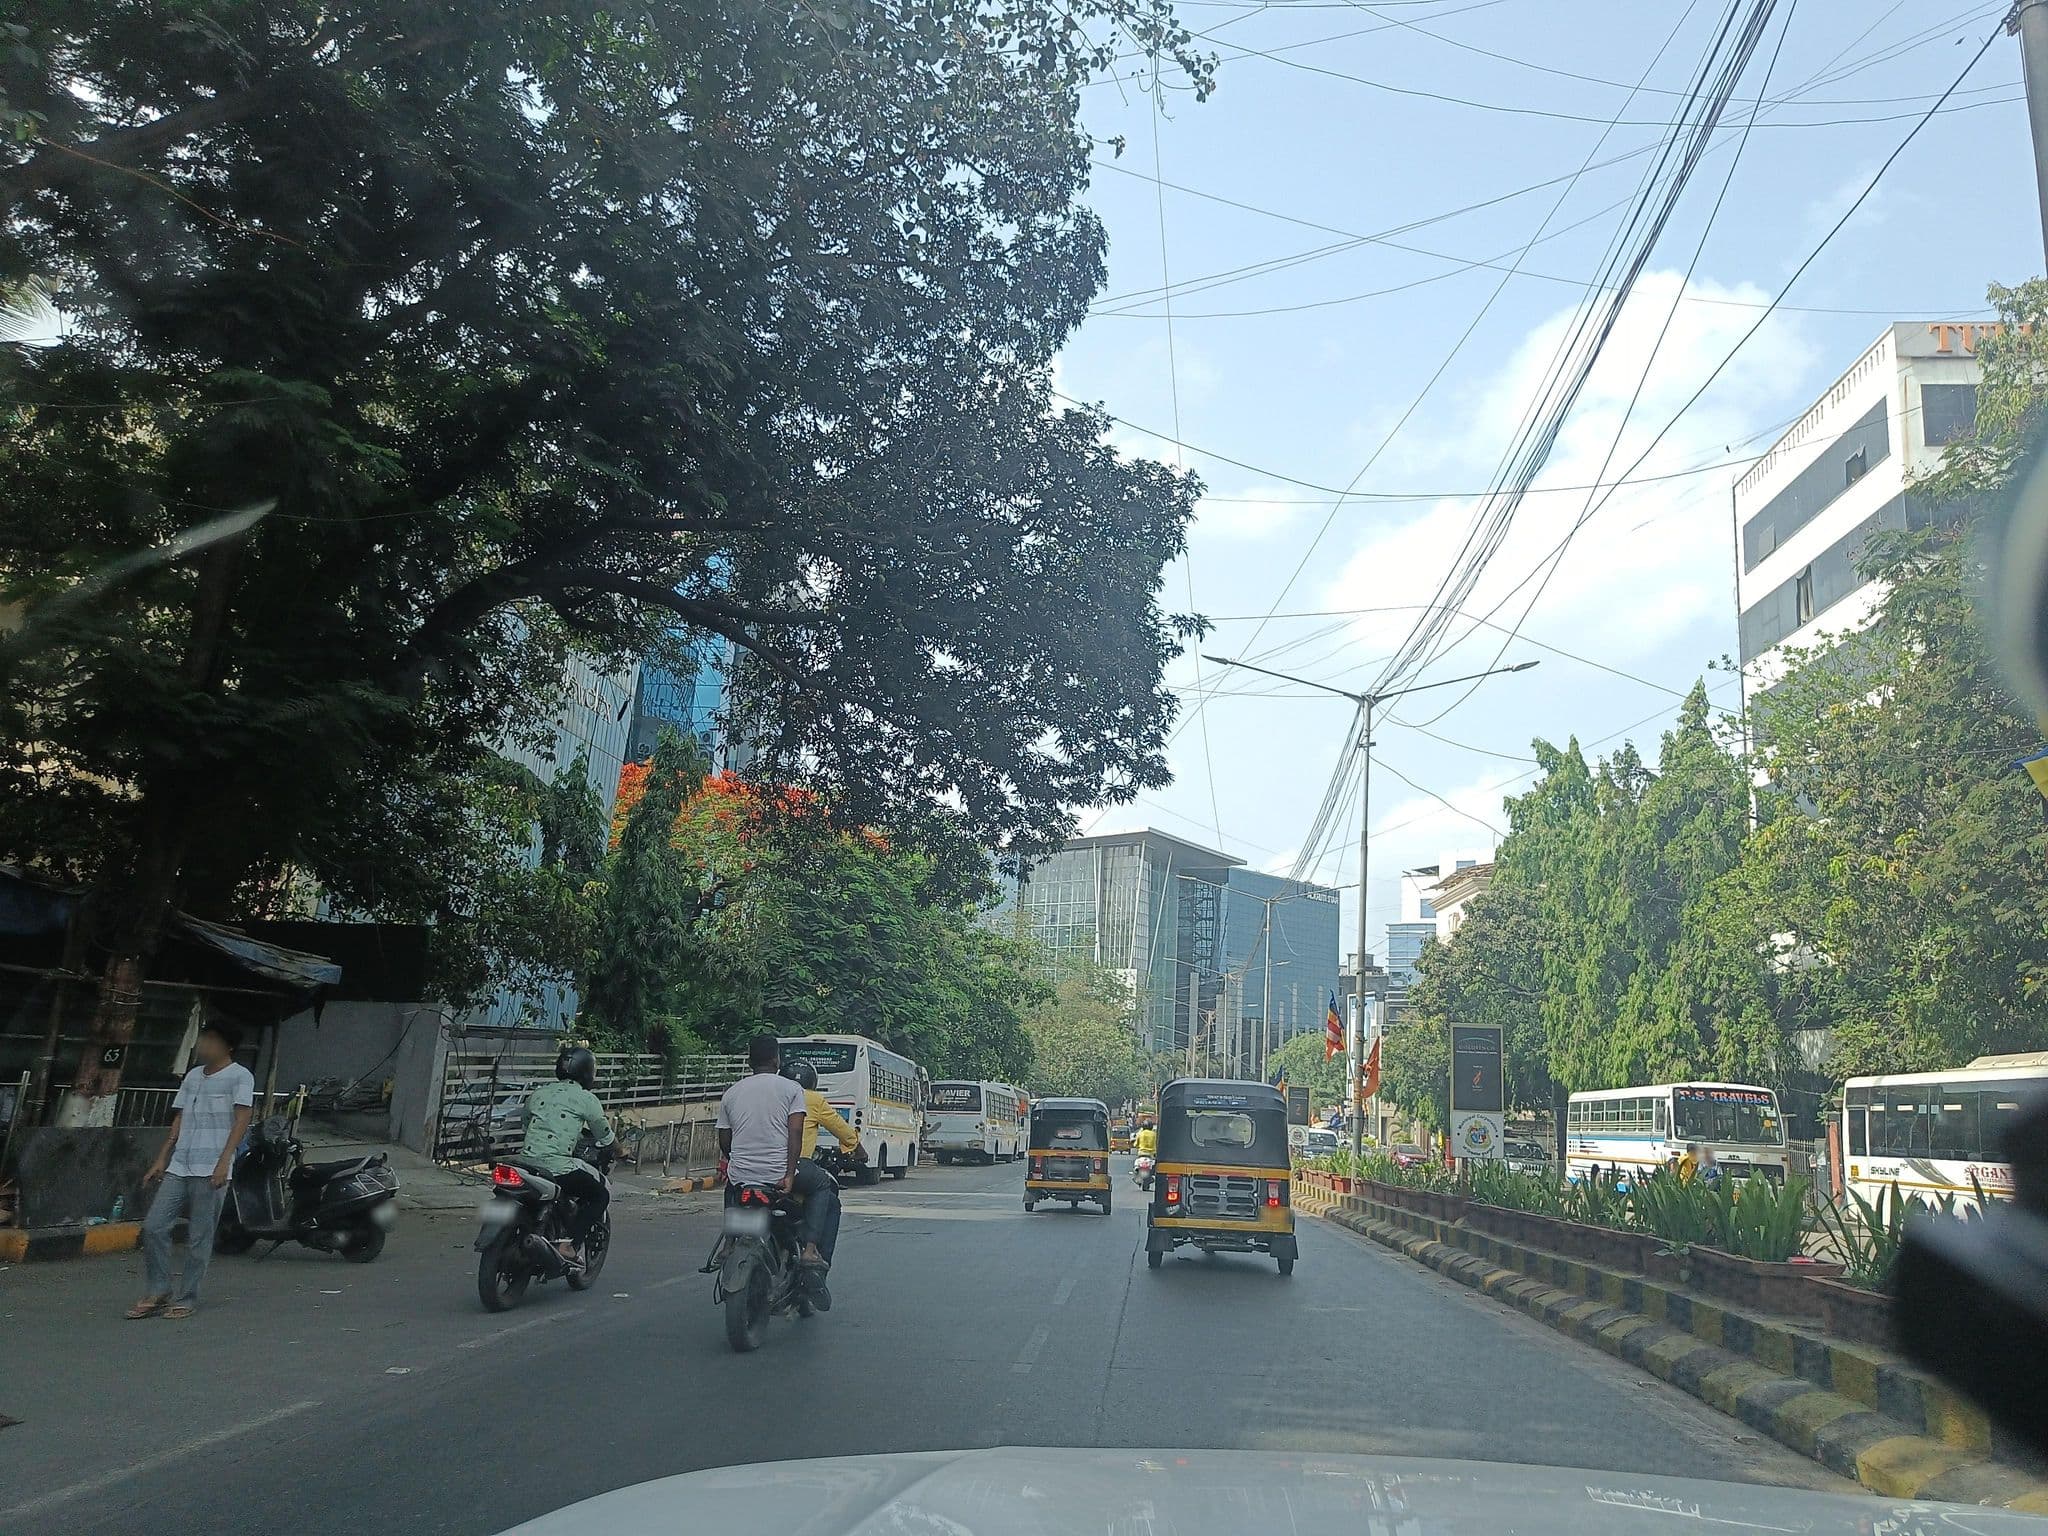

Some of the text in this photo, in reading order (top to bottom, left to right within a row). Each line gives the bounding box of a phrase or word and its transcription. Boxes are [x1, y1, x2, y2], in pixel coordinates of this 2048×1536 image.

[938, 1089, 971, 1097] XAVIER
[1710, 1091, 1769, 1105] TRAVELS
[1870, 1166, 1900, 1176] SKYLINE
